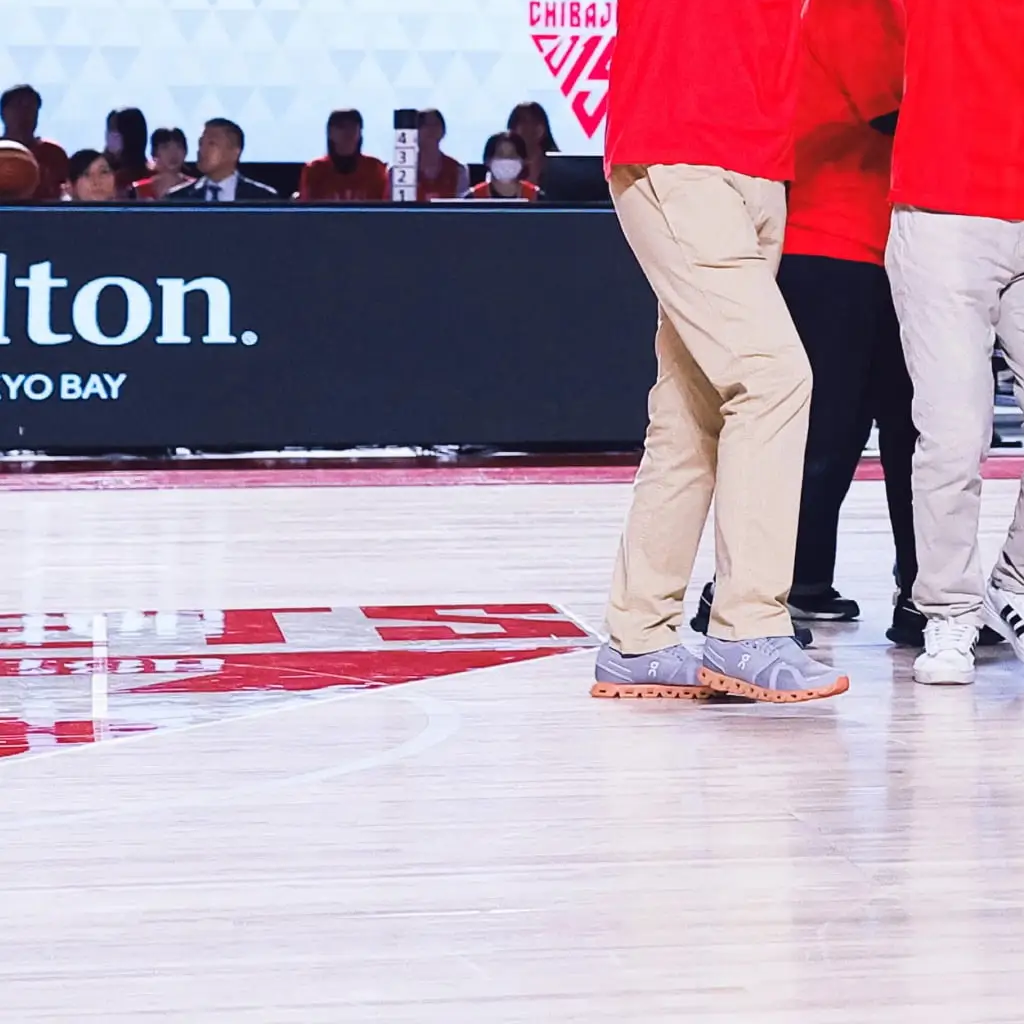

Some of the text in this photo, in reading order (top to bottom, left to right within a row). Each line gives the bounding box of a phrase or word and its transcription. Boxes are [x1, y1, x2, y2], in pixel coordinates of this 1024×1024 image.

[398, 131, 407, 144] 4
[399, 150, 407, 164] 3
[398, 169, 406, 183] 2
[0, 373, 127, 400] YO BAY
